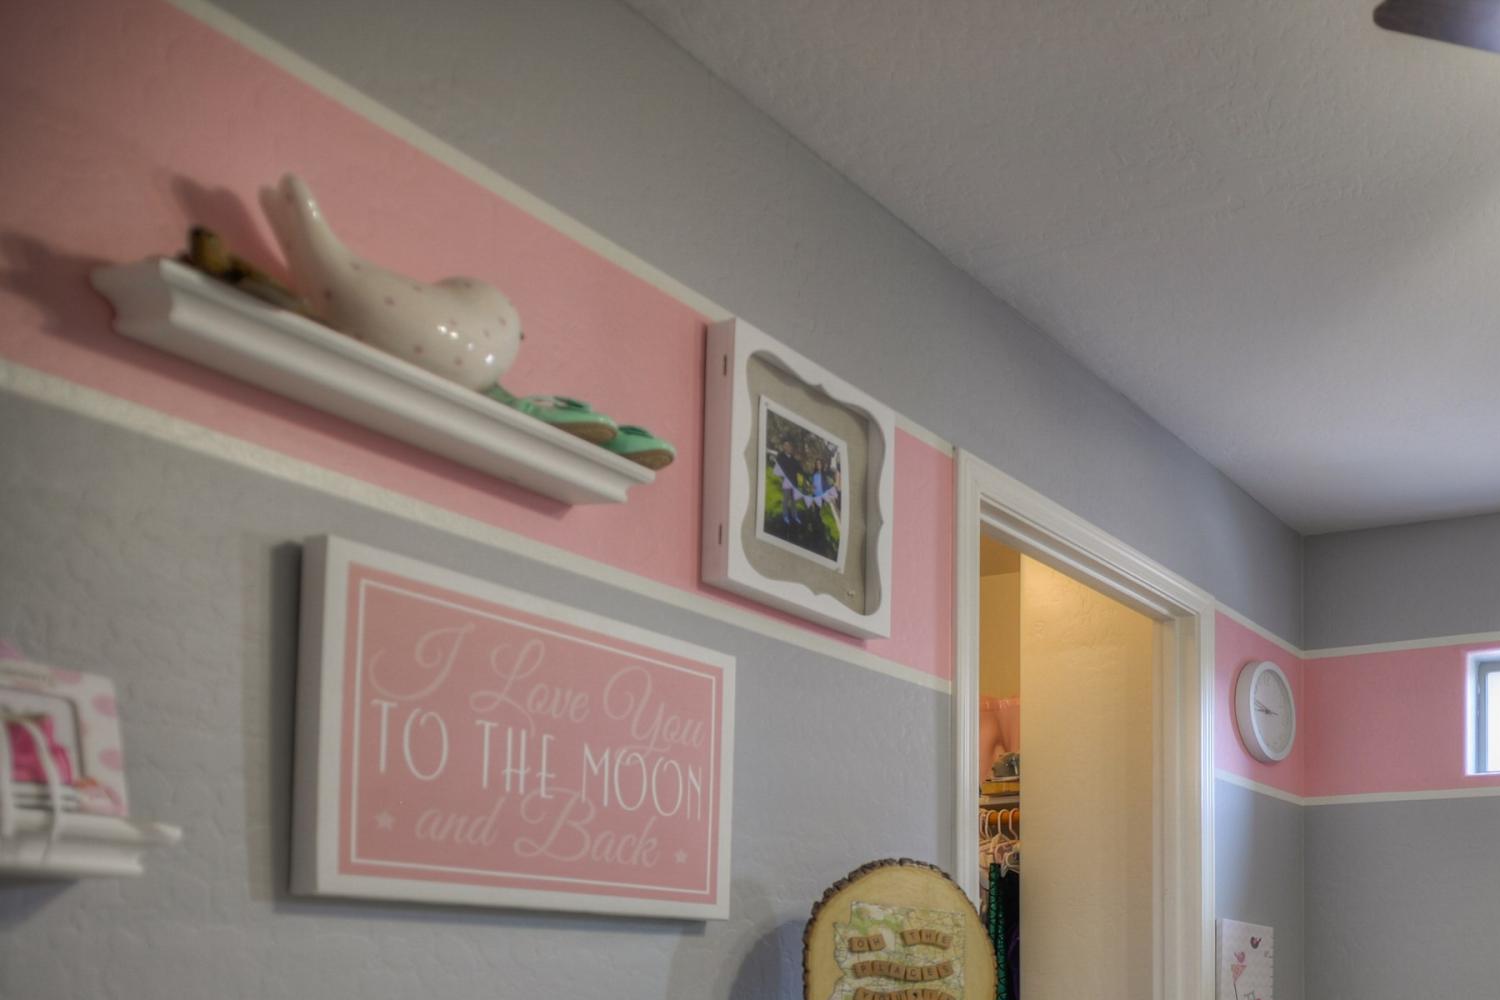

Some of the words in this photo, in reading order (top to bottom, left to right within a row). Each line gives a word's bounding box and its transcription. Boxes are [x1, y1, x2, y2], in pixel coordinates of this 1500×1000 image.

[468, 637, 592, 737] Love
[602, 665, 705, 758] You
[371, 698, 449, 781] TO
[475, 719, 557, 799] THE
[583, 742, 702, 822] MOON
[414, 795, 507, 845] and
[513, 788, 660, 868] Back
[854, 936, 882, 949] OH
[906, 930, 952, 947] THE
[857, 962, 951, 979] PLACES
